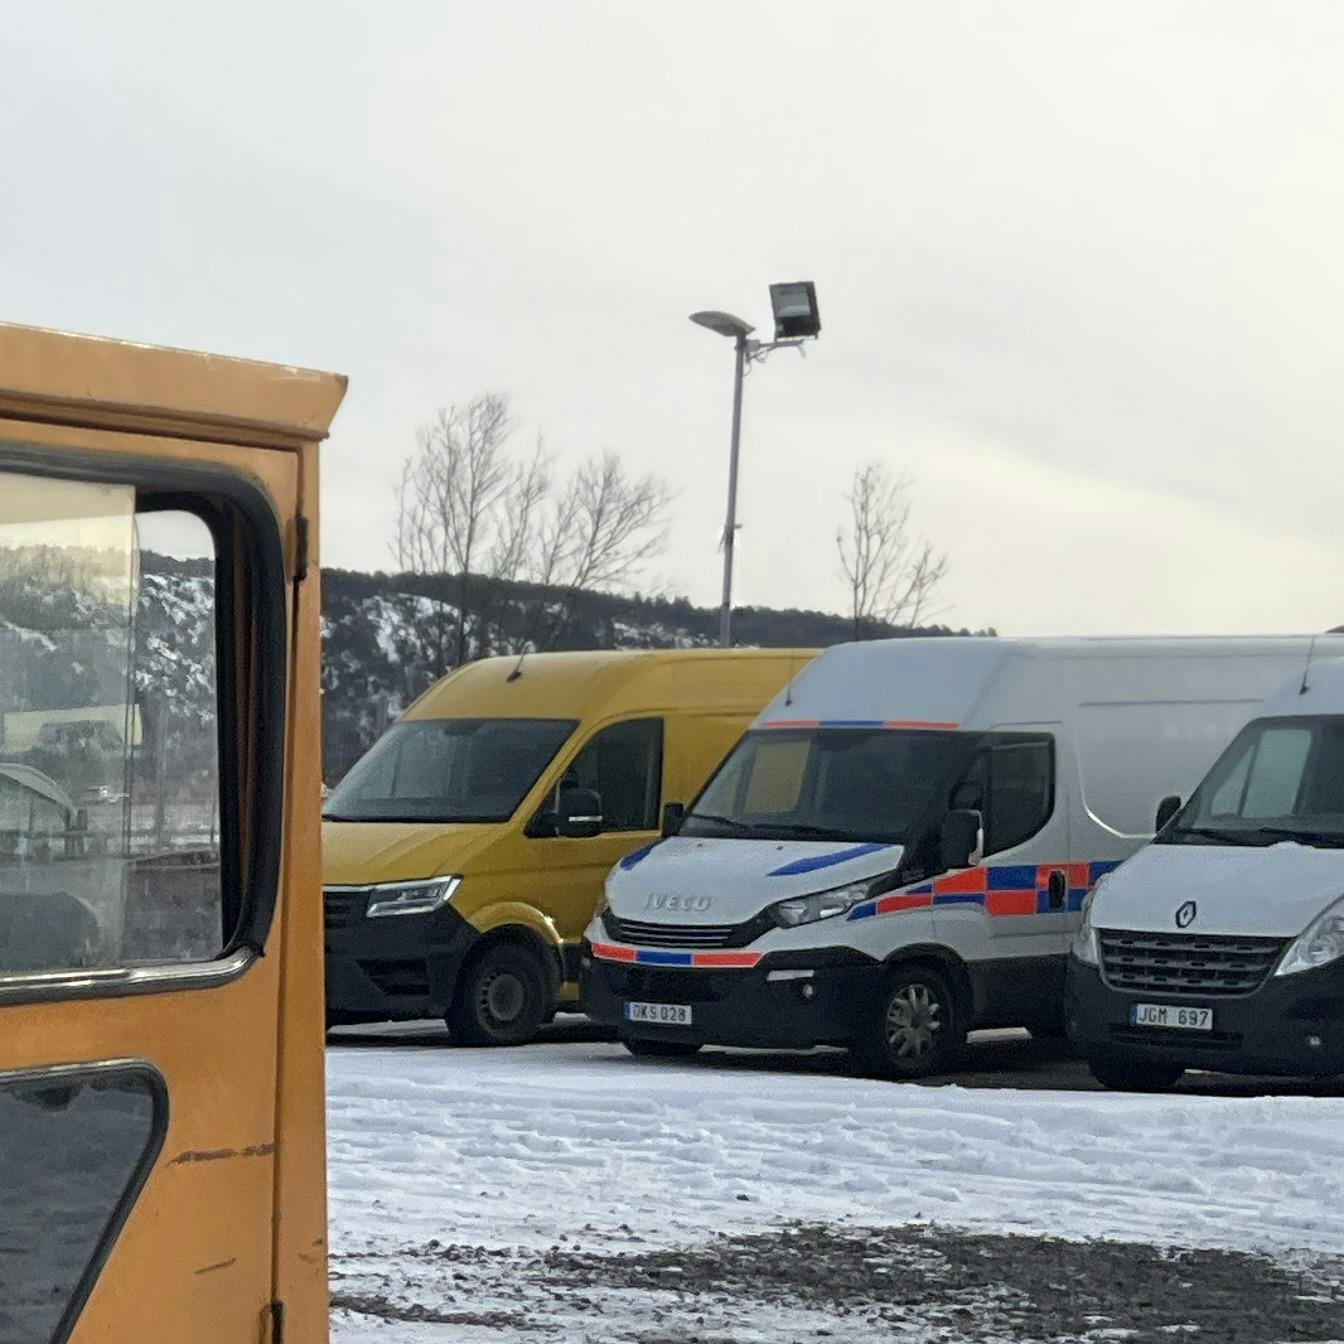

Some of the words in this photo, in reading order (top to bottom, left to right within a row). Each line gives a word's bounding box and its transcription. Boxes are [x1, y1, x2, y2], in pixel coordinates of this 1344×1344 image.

[643, 891, 713, 912] IVECO
[1138, 1006, 1168, 1025] JGM
[1178, 1009, 1209, 1027] 697
